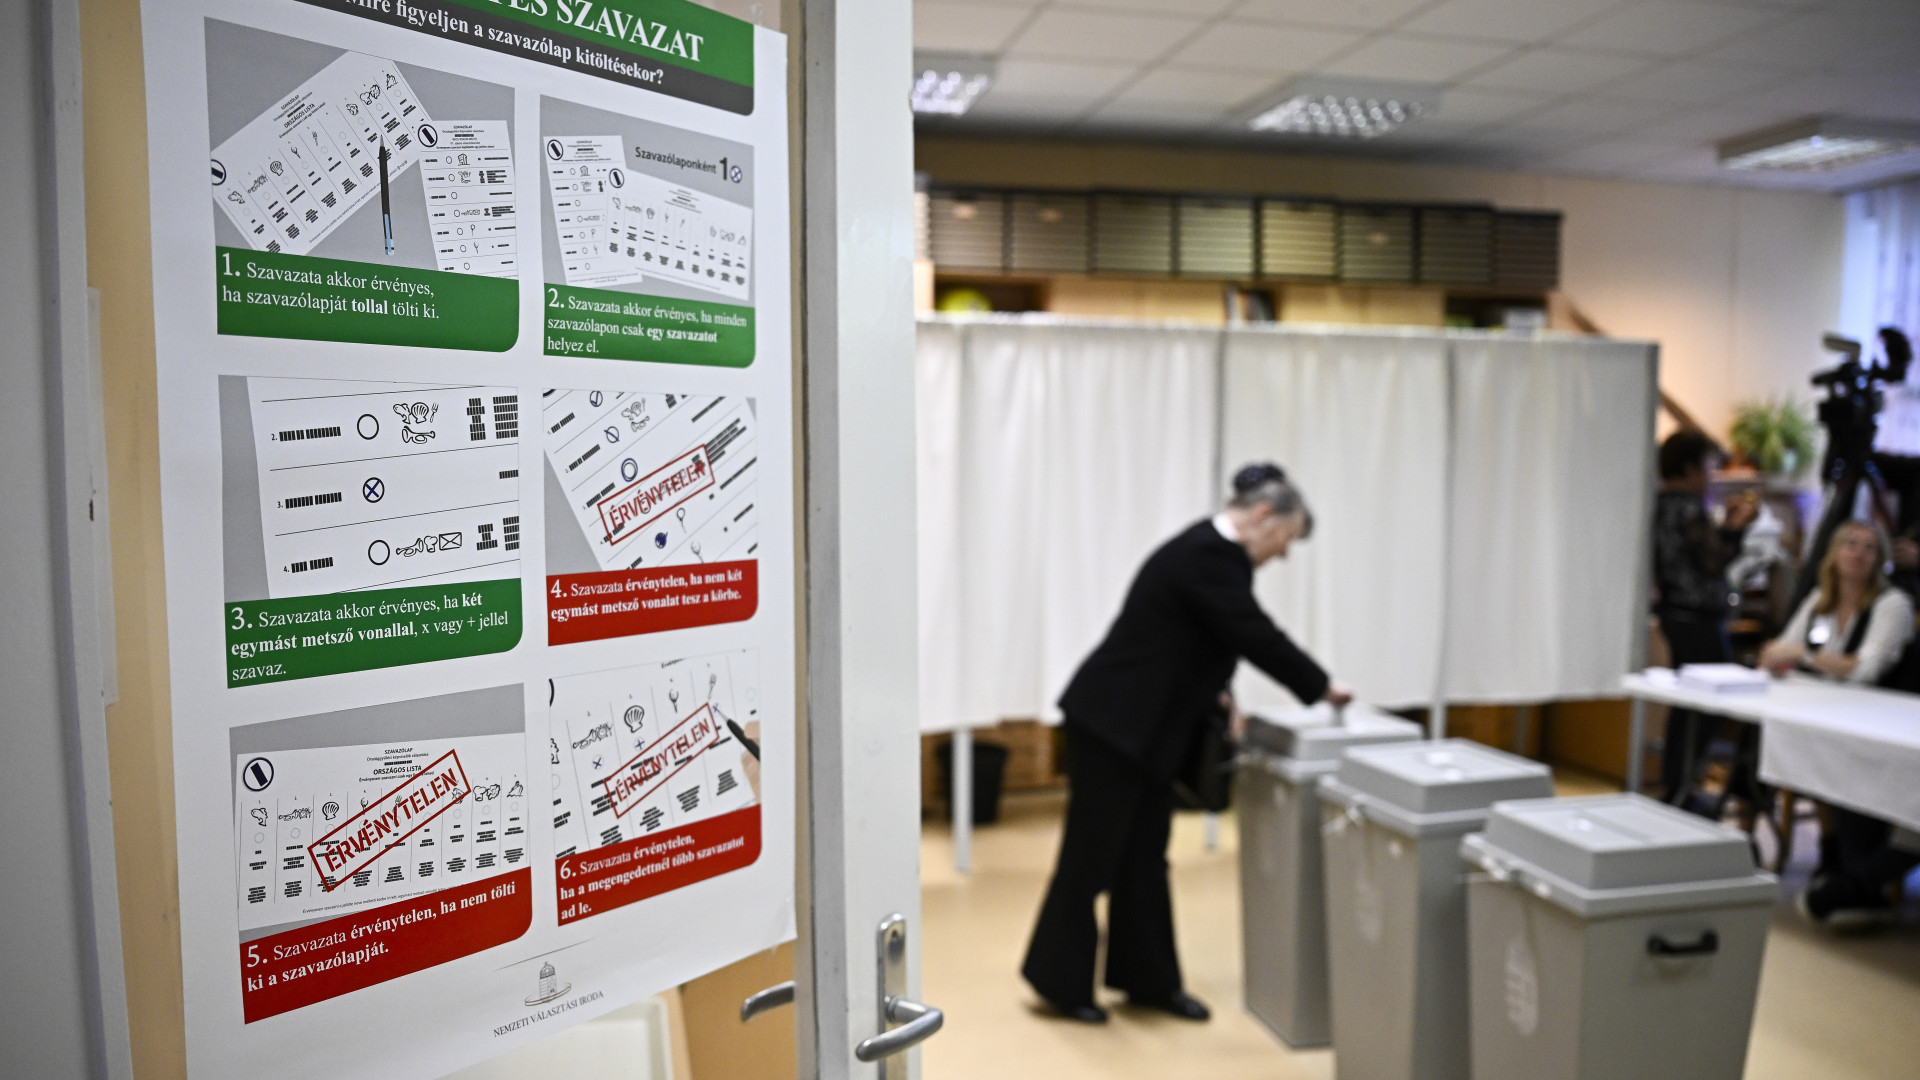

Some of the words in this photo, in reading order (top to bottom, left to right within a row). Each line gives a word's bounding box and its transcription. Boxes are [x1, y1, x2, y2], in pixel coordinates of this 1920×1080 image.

[396, 0, 469, 34] figyeljen
[474, 24, 483, 38] a
[488, 27, 572, 63] szavazólap
[576, 46, 664, 85] kitöltésekor?
[556, 0, 704, 62] SZAVAZAT
[635, 147, 717, 175] Szavazólaponként
[720, 156, 728, 181] 1
[222, 252, 241, 277] 1.
[246, 261, 322, 286] Szavazata
[326, 271, 367, 289] akkor
[371, 275, 434, 298] érvényes,
[222, 285, 242, 303] ha
[246, 290, 347, 314] szavazólapját
[351, 298, 388, 315] tollal
[392, 301, 419, 317] tölti
[423, 303, 440, 319] ki.
[547, 288, 565, 309] 2.
[568, 296, 621, 314] Szavazata
[623, 302, 652, 317] akkor
[654, 306, 699, 323] érvényes,
[701, 310, 713, 323] ha
[714, 311, 747, 327] minden
[547, 318, 620, 337] szavazólapon
[622, 323, 645, 337] csak
[646, 327, 664, 341] egy
[666, 329, 718, 343] szavazatot
[547, 336, 584, 354] helyez
[586, 339, 600, 353] el.
[608, 459, 707, 530] ÉRVÉNYTELEN
[550, 579, 568, 598] 4.
[571, 582, 624, 598] Szavazata
[625, 577, 688, 593] érvénytelen,
[690, 573, 703, 585] ha
[704, 572, 726, 585] nem
[727, 569, 742, 582] két
[550, 602, 599, 622] egymást
[601, 597, 640, 615] metsző
[641, 593, 680, 610] vonalat
[682, 593, 701, 606] tesz
[702, 594, 709, 603] a
[710, 588, 742, 603] körbe.
[231, 606, 253, 630] 3.
[259, 608, 332, 628] Szavazata
[336, 603, 376, 620] akkor
[379, 599, 440, 616] érvényes,
[443, 594, 459, 609] ha
[461, 592, 483, 608] két
[231, 634, 298, 659] egymást
[302, 627, 354, 648] metsző
[357, 621, 418, 641] vonallal,
[421, 623, 430, 634] x
[433, 619, 464, 635] vagy
[467, 616, 476, 627] +
[477, 610, 509, 632] jellel
[232, 663, 287, 681] szavaz.
[373, 766, 406, 775] ORSZÁGOS
[406, 765, 422, 773] LISTA
[615, 718, 711, 802] ÉRVÉNYTELEN
[323, 768, 461, 872] ÉRVÉNYTELEN
[560, 858, 577, 880] 6.
[579, 853, 632, 875] Szavazata
[633, 834, 695, 859] érvénytelen,
[560, 886, 575, 900] ha
[578, 885, 586, 896] a
[588, 857, 670, 892] megengedettnél
[671, 850, 695, 867] több
[697, 836, 745, 859] szavazatot
[246, 944, 268, 968] 5.
[273, 932, 347, 961] Szavazata
[350, 907, 437, 940] érvénytelen,
[440, 899, 457, 915] ha
[460, 891, 488, 909] nem
[490, 881, 516, 901] tölti
[561, 904, 576, 920] ad
[578, 901, 592, 915] le.
[247, 976, 263, 992] ki
[268, 973, 278, 986] a
[282, 940, 389, 983] szavazólapját.
[493, 1017, 529, 1038] NEMZETI
[530, 998, 578, 1024] VÁLASZTÁSI
[579, 990, 604, 1006] IRODA
